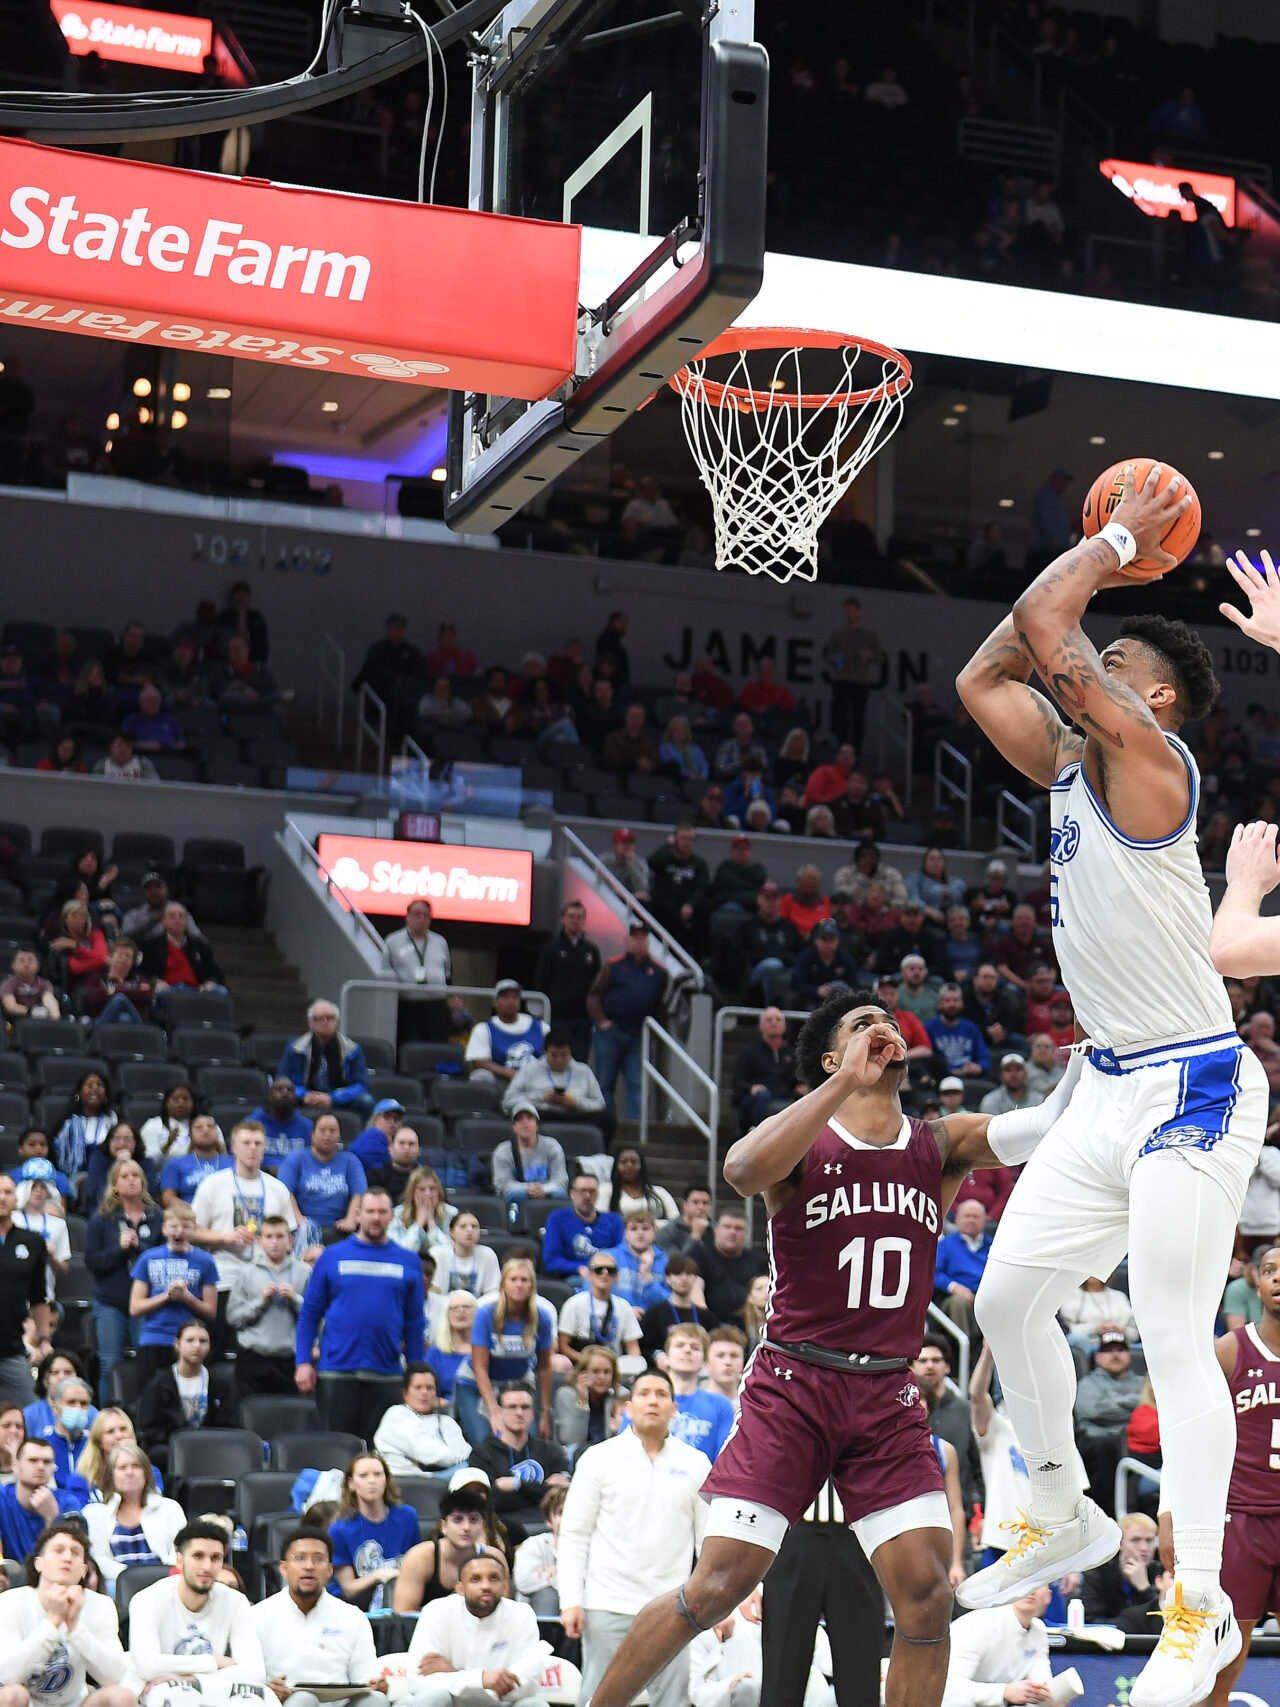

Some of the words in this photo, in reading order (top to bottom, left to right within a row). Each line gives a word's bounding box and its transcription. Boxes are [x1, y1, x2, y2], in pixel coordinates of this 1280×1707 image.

[2, 186, 190, 273] State
[193, 219, 371, 302] Farm
[1222, 647, 1268, 675] 103
[806, 1182, 938, 1235] SALUKIS
[838, 1236, 913, 1310] 10
